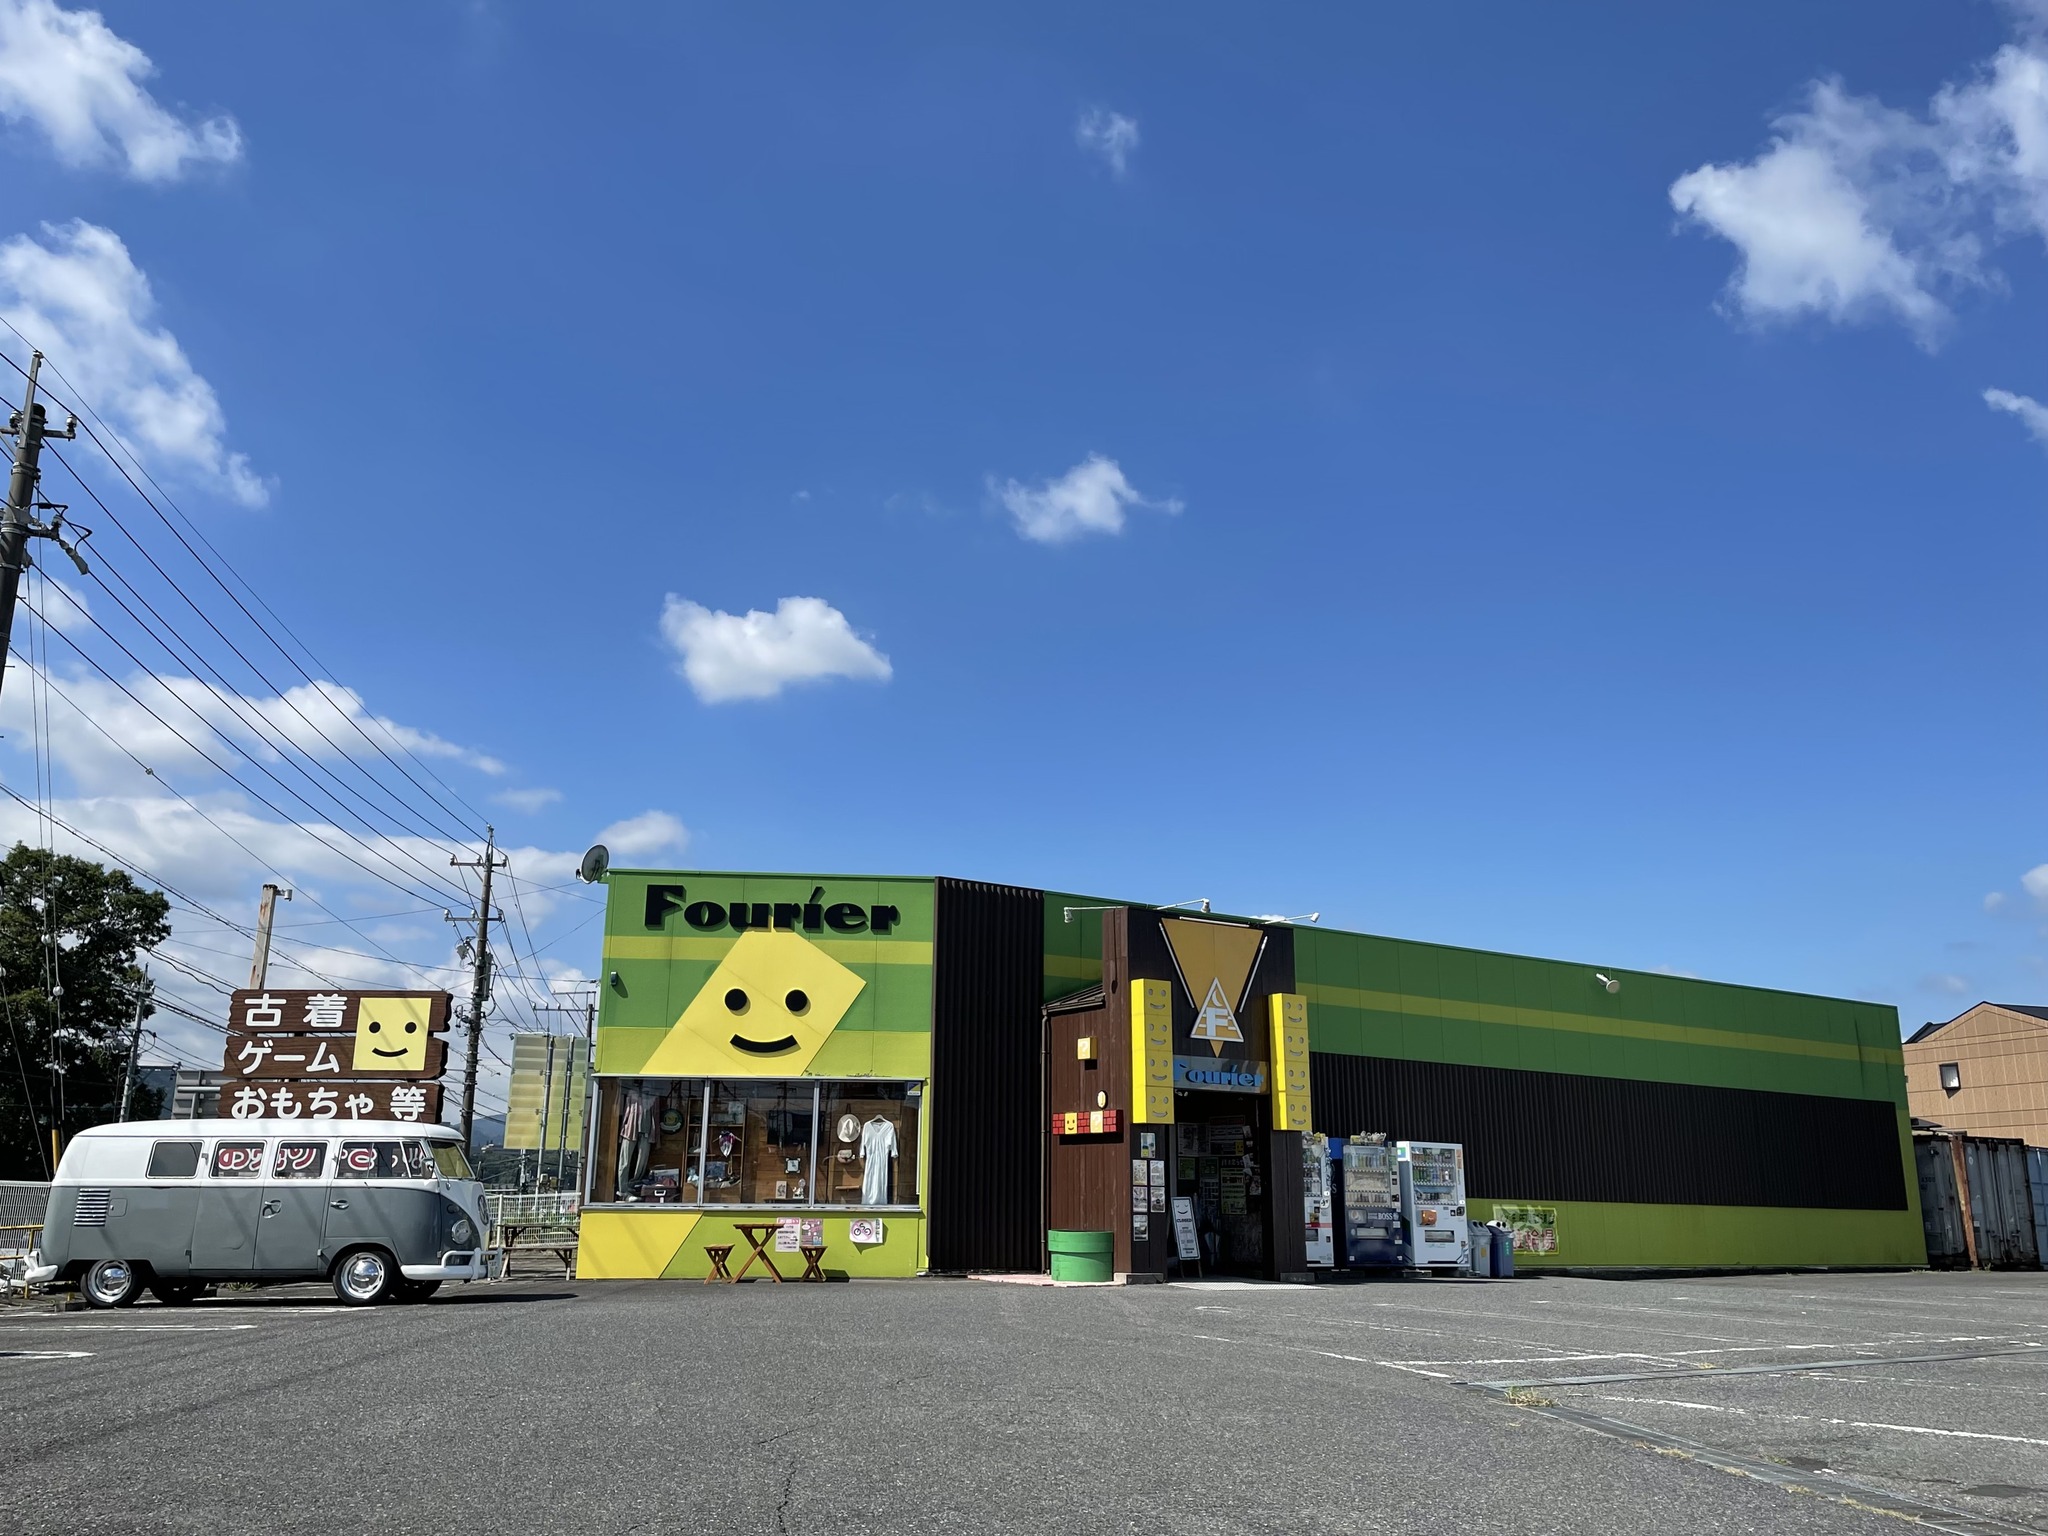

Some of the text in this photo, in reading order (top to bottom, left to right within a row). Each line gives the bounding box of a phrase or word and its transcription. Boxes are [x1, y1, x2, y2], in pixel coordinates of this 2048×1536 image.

[245, 993, 347, 1027] 古着
[1206, 1007, 1228, 1037] F
[238, 1039, 340, 1075] ゲーム
